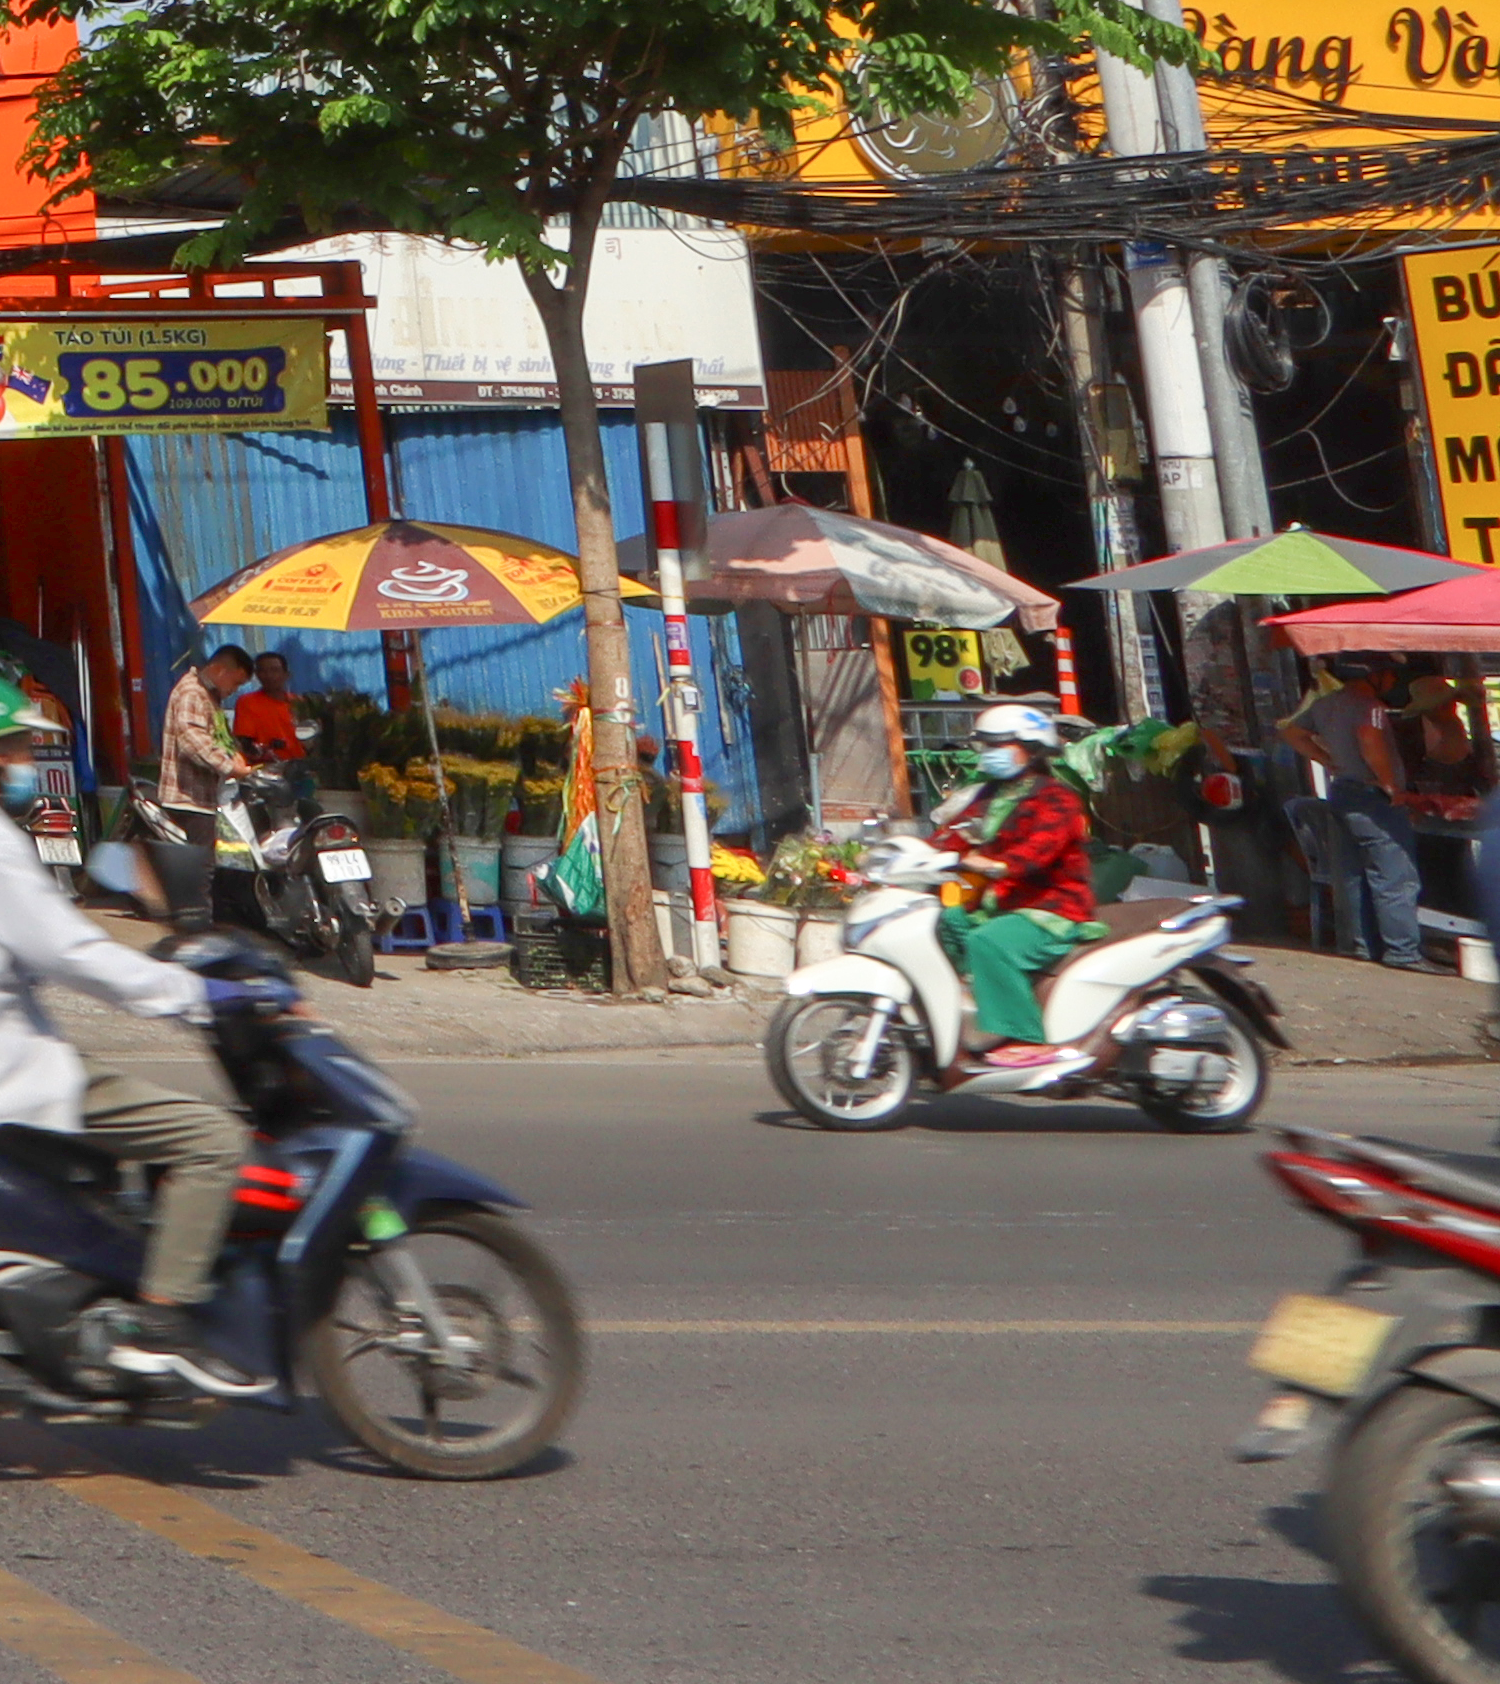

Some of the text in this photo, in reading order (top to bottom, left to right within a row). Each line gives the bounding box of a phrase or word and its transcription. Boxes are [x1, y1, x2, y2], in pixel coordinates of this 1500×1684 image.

[54, 327, 207, 349] TÁO TÚI (1.5KG)
[82, 356, 268, 412] 85.000
